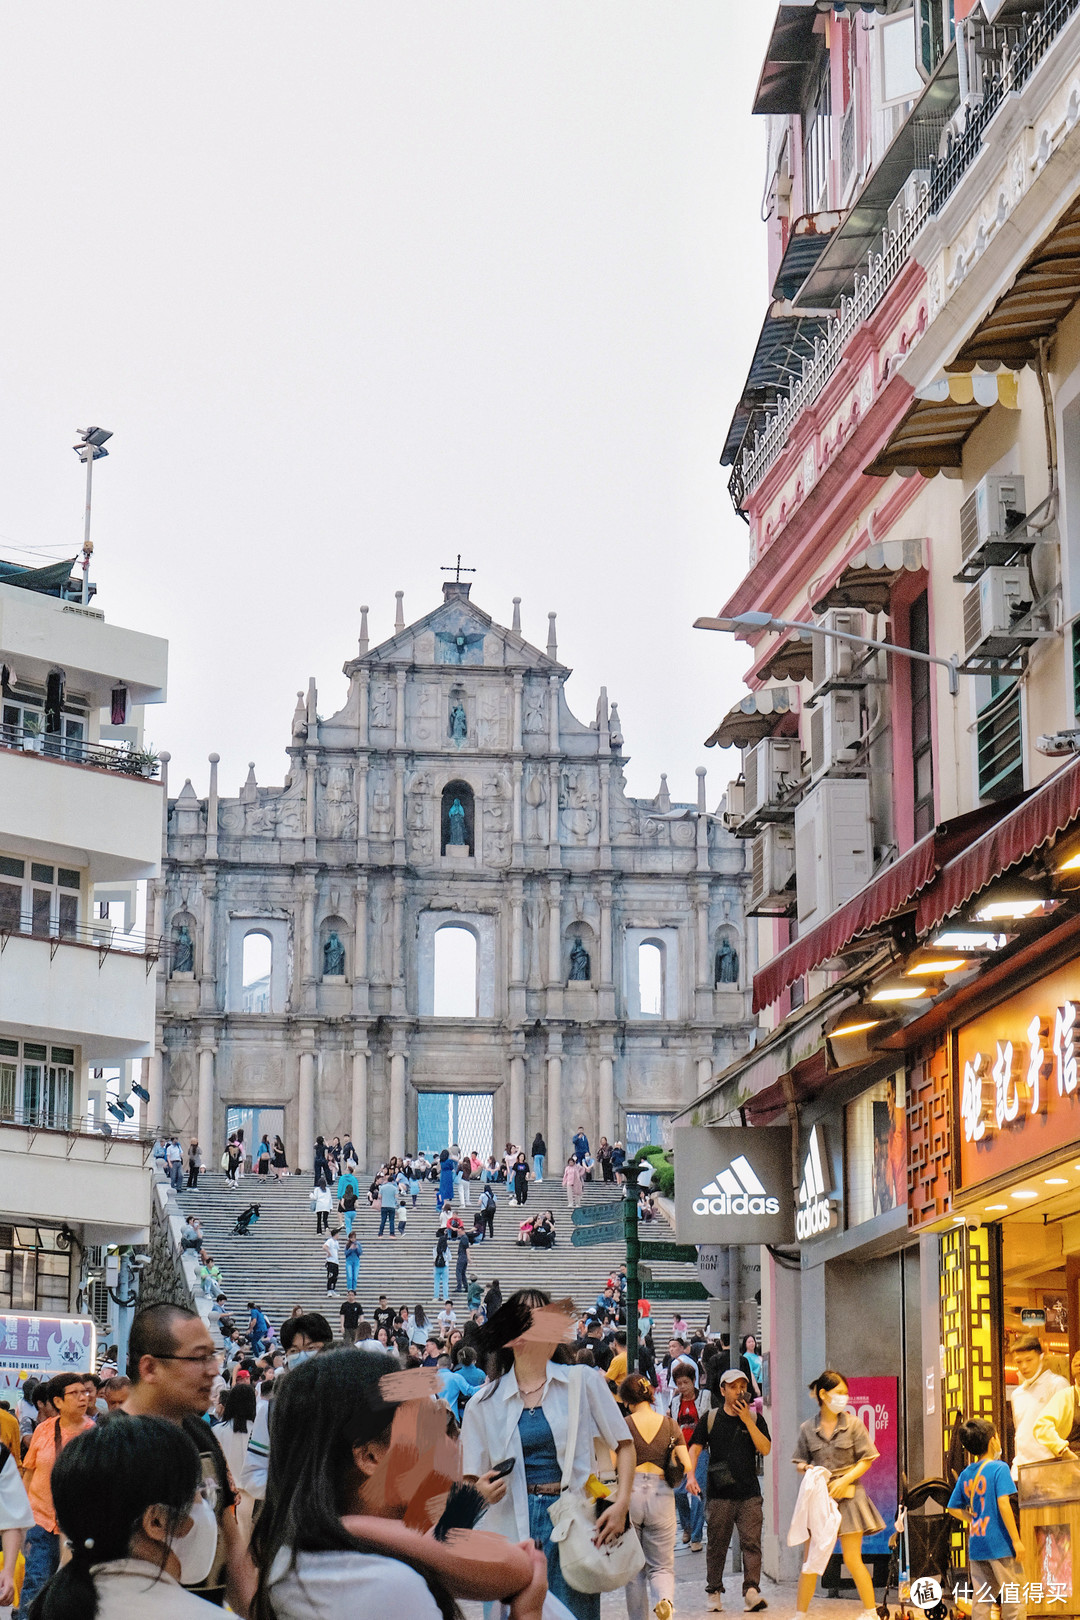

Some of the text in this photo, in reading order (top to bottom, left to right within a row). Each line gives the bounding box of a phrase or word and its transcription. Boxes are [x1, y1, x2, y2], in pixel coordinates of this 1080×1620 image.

[692, 1192, 780, 1215] adidas
[796, 1193, 831, 1240] adidas
[875, 1420, 888, 1430] OFF
